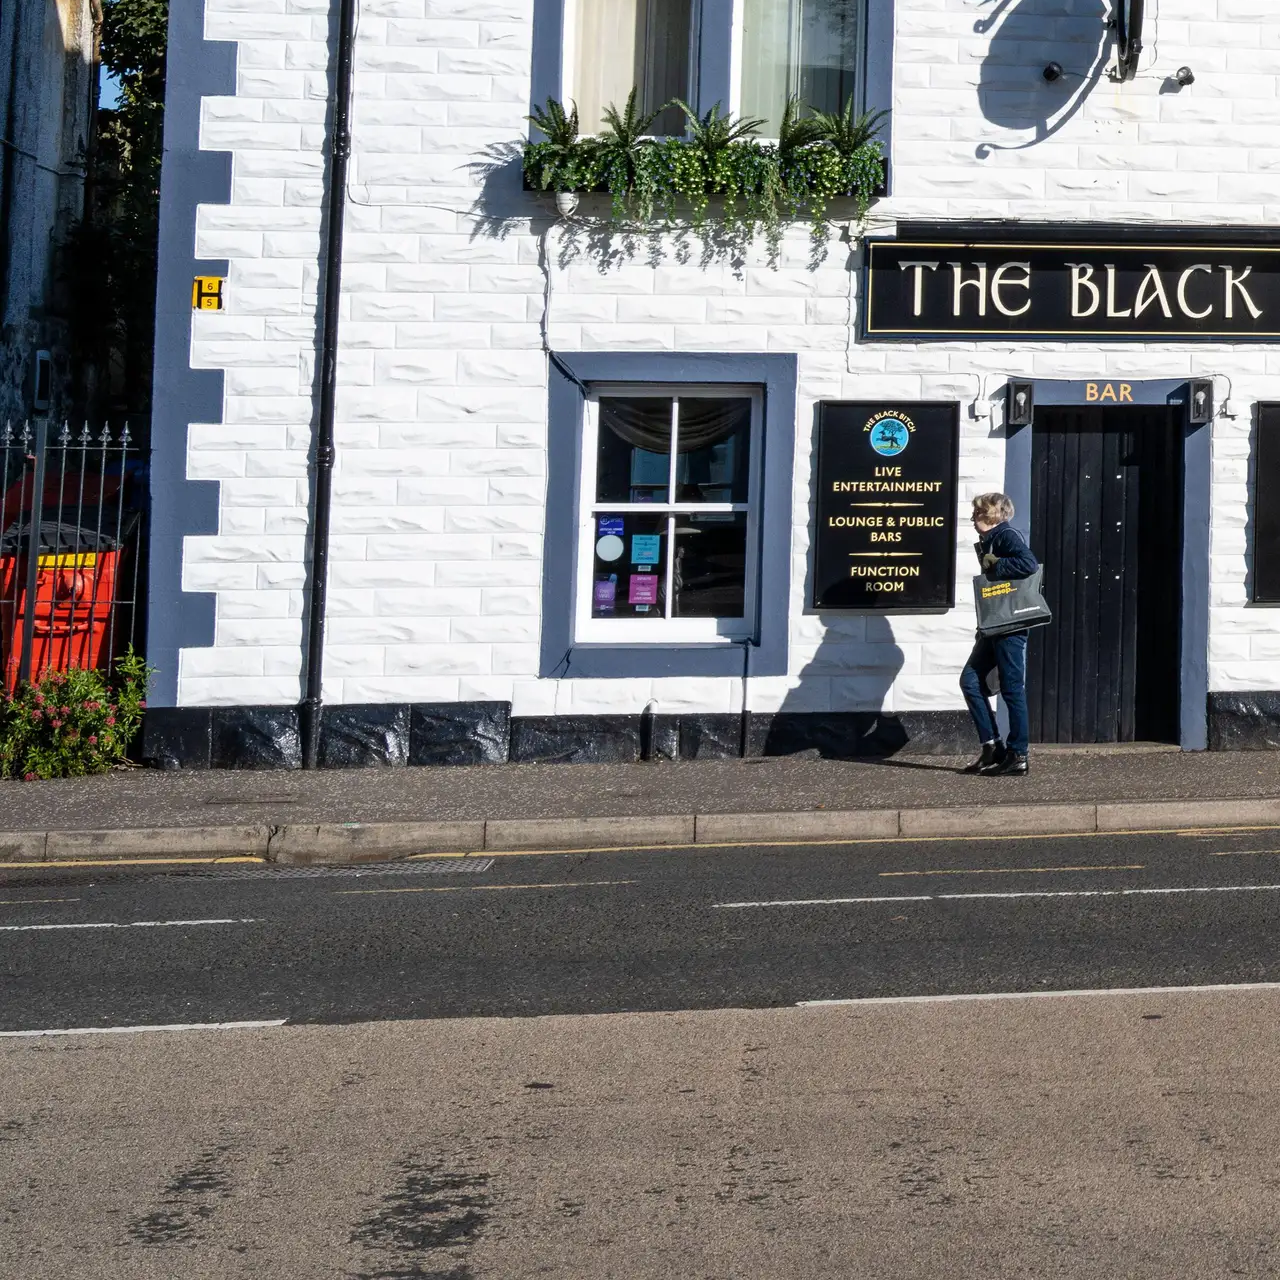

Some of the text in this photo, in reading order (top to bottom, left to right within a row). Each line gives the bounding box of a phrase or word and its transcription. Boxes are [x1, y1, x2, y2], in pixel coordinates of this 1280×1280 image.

[898, 261, 1032, 318] THE
[1064, 262, 1263, 319] BLACK
[1085, 383, 1134, 402] BAR
[863, 410, 917, 433] THE BLACK BITCH
[874, 467, 902, 477] LIVE
[832, 482, 942, 492] ENTERTAINMENT
[829, 516, 944, 527] LOUNGE & PUBLIC
[870, 532, 902, 542] BARS
[850, 566, 920, 577] FUNCTION
[865, 581, 904, 592] ROOM
